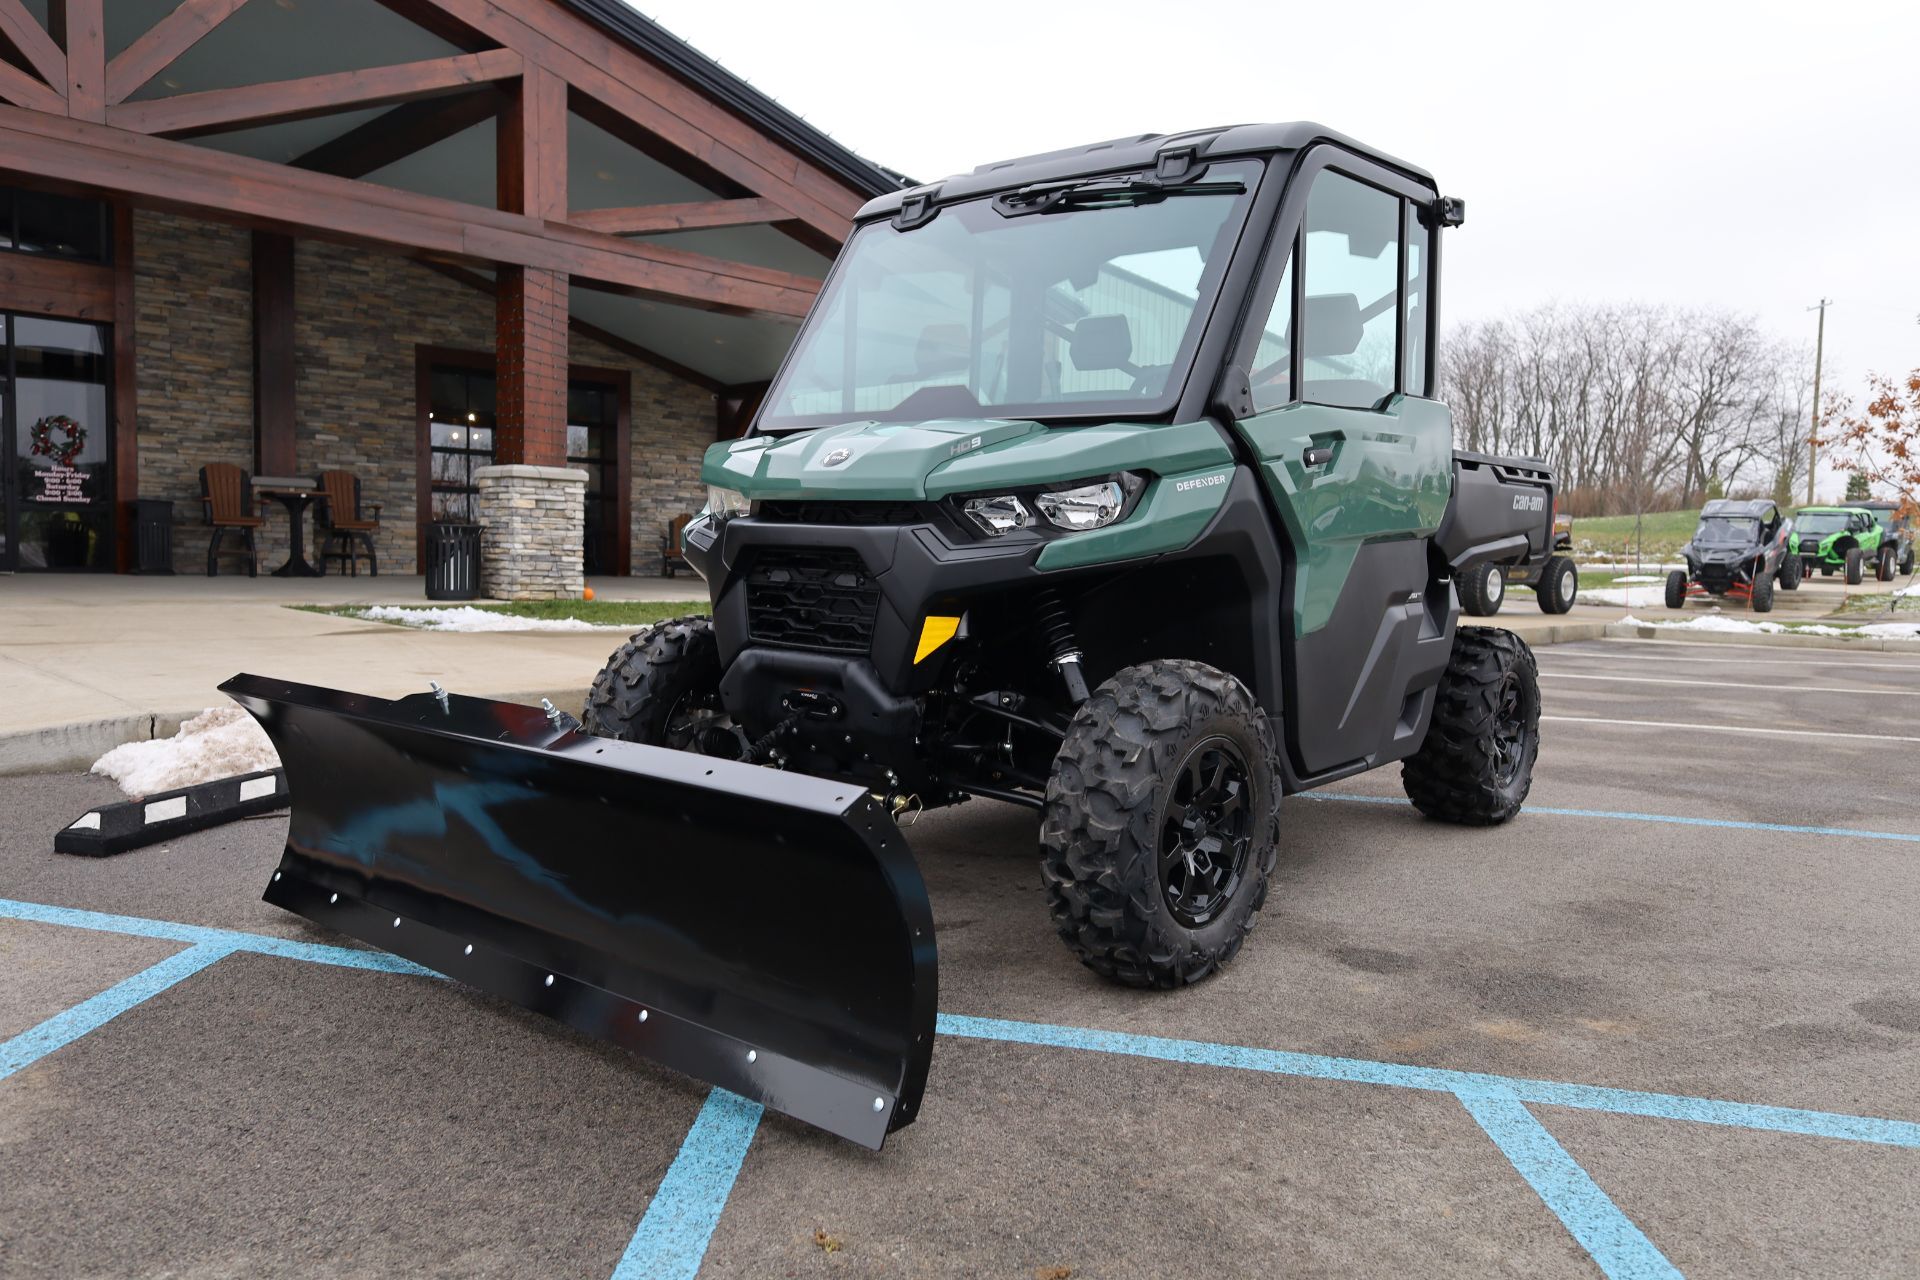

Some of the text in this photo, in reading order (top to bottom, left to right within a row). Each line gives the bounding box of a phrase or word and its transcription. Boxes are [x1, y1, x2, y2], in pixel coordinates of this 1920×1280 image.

[950, 436, 982, 456] HD9
[51, 464, 75, 472] Hours
[34, 470, 91, 480] Monday-Friday
[46, 483, 80, 491] Saturday
[1176, 474, 1226, 492] DEFENDER
[36, 494, 91, 504] Closed Sunday
